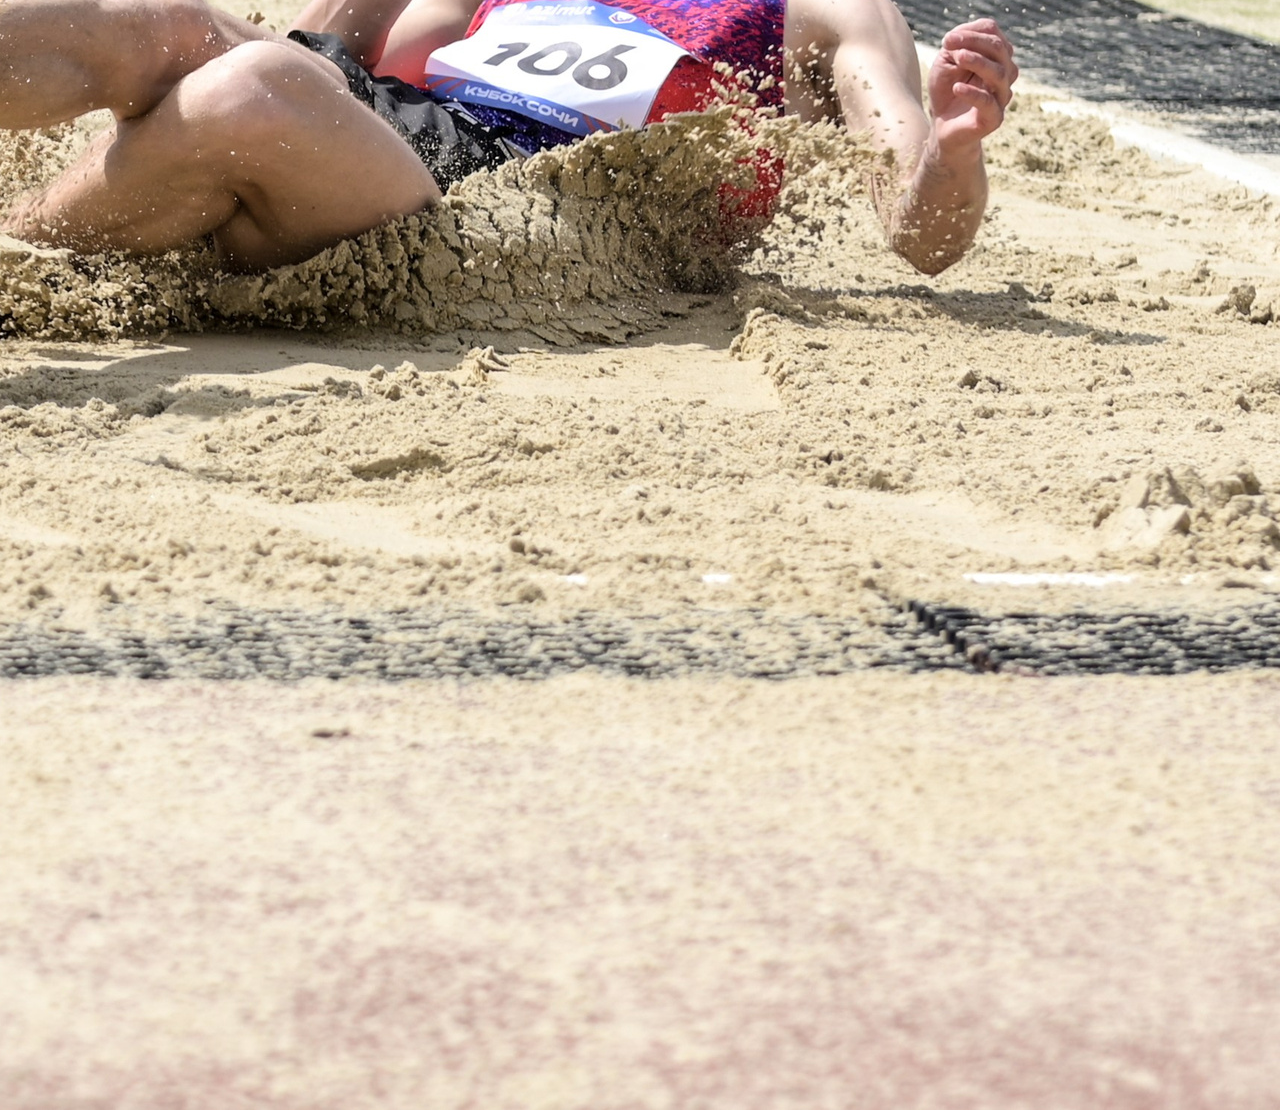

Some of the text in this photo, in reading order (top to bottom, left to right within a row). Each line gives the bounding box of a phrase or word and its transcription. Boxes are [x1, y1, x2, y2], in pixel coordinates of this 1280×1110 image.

[530, 3, 596, 16] azimut
[482, 41, 637, 91] 106
[464, 85, 579, 127] КУБОК СОЧИ
